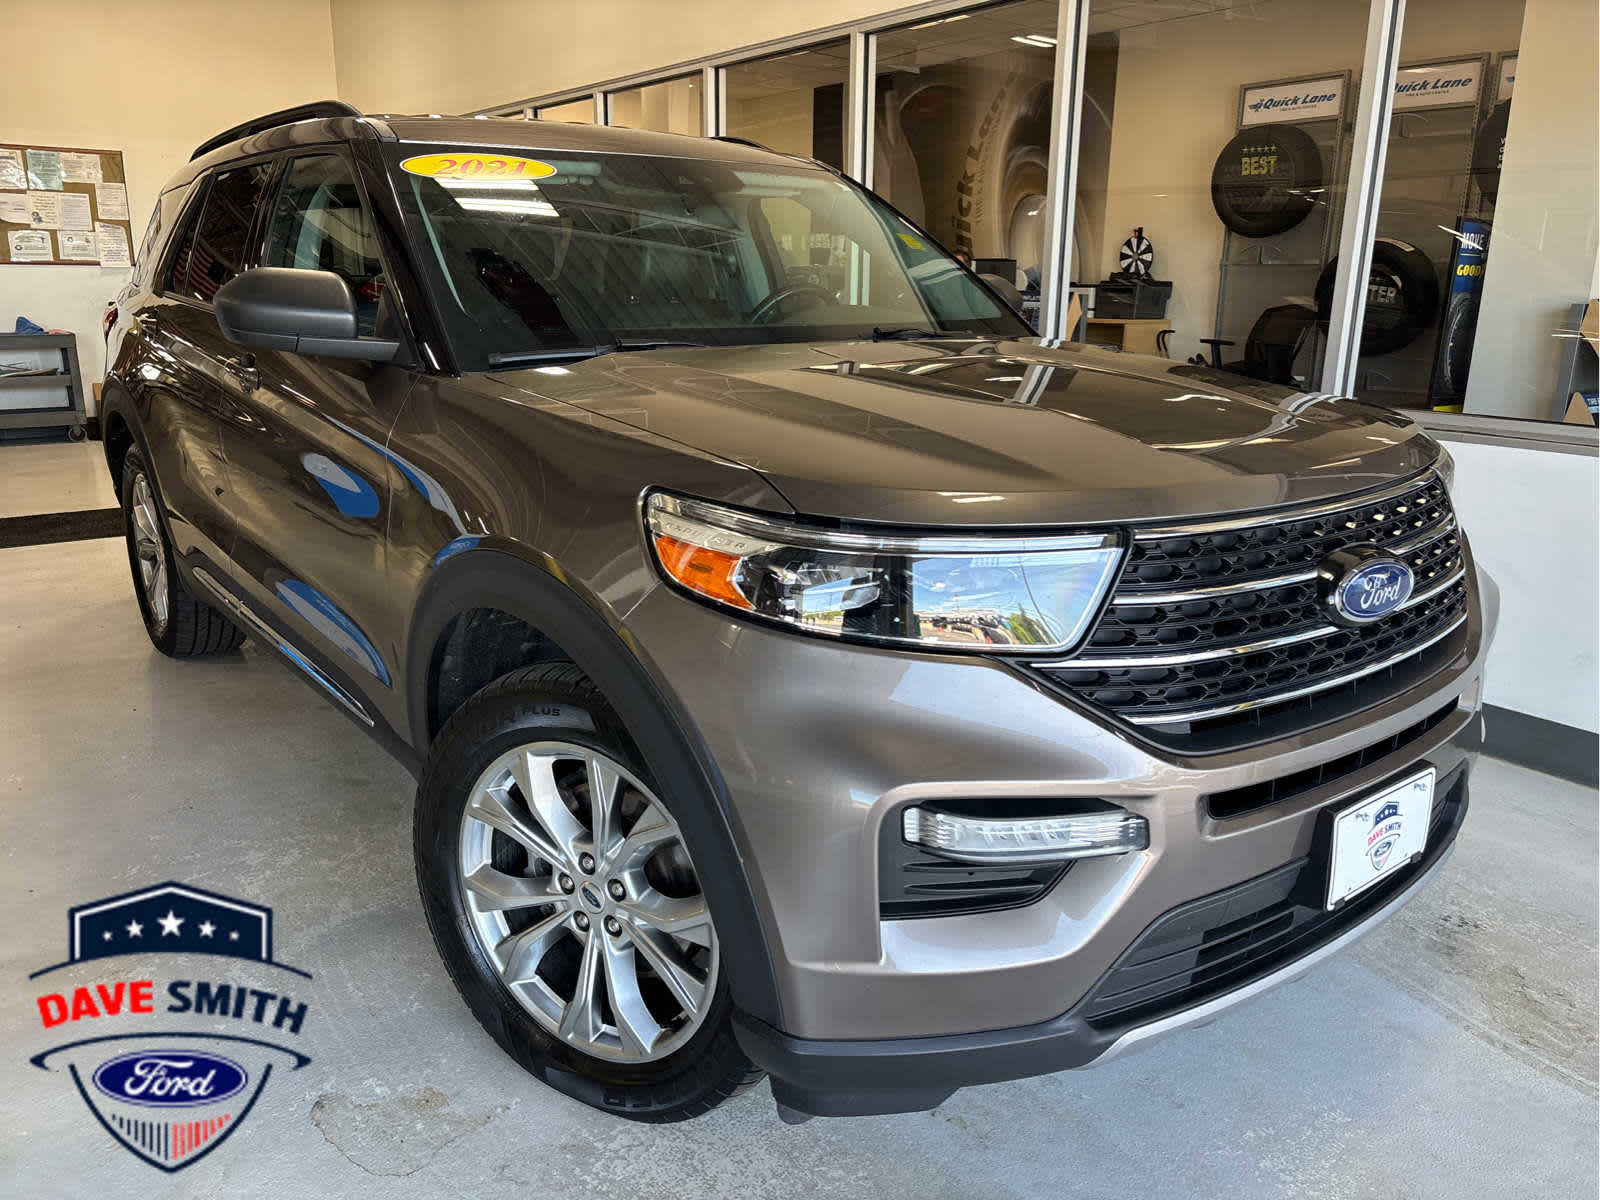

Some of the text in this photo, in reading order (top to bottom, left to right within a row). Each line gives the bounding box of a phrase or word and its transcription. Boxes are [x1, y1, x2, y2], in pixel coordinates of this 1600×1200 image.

[1431, 77, 1473, 90] Lane
[1263, 95, 1300, 110] Quick
[1301, 92, 1337, 105] Lane
[434, 158, 528, 176] 2021
[1241, 155, 1278, 176] BEST
[1360, 570, 1403, 610] Ford
[1367, 821, 1402, 847] DAVE SMITH
